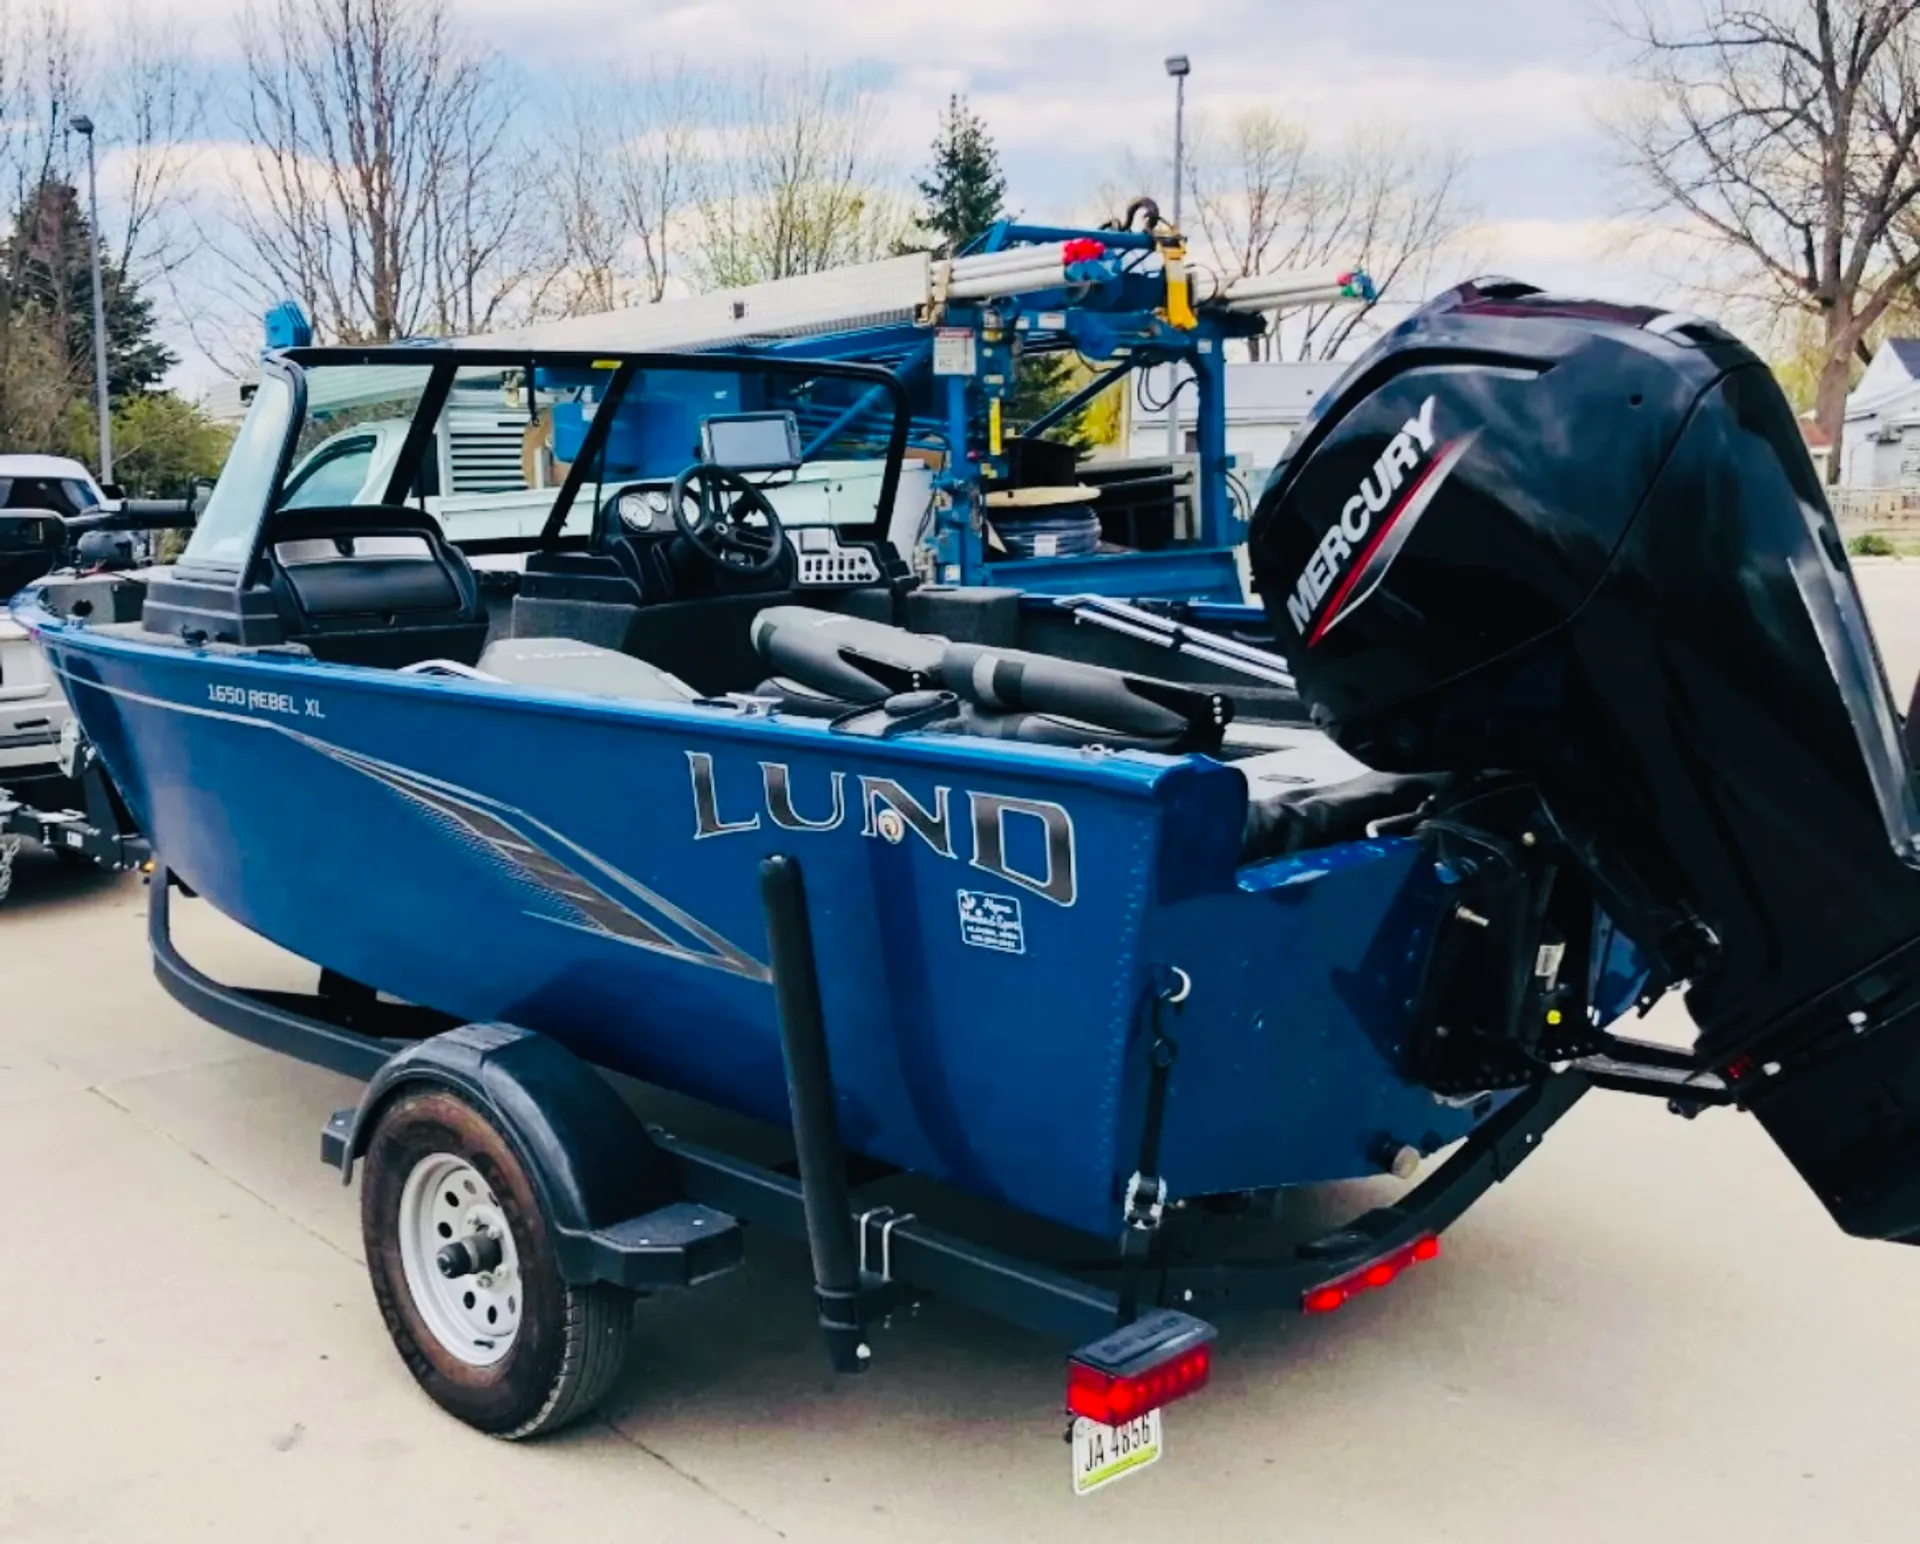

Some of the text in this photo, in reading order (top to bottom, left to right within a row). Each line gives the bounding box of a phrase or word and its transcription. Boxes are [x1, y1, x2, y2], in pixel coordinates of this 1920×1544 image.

[1287, 395, 1435, 635] MERCURY
[208, 684, 326, 718] 1650 REBEL XL
[684, 750, 1077, 907] LUND
[1085, 1434, 1104, 1472] JA
